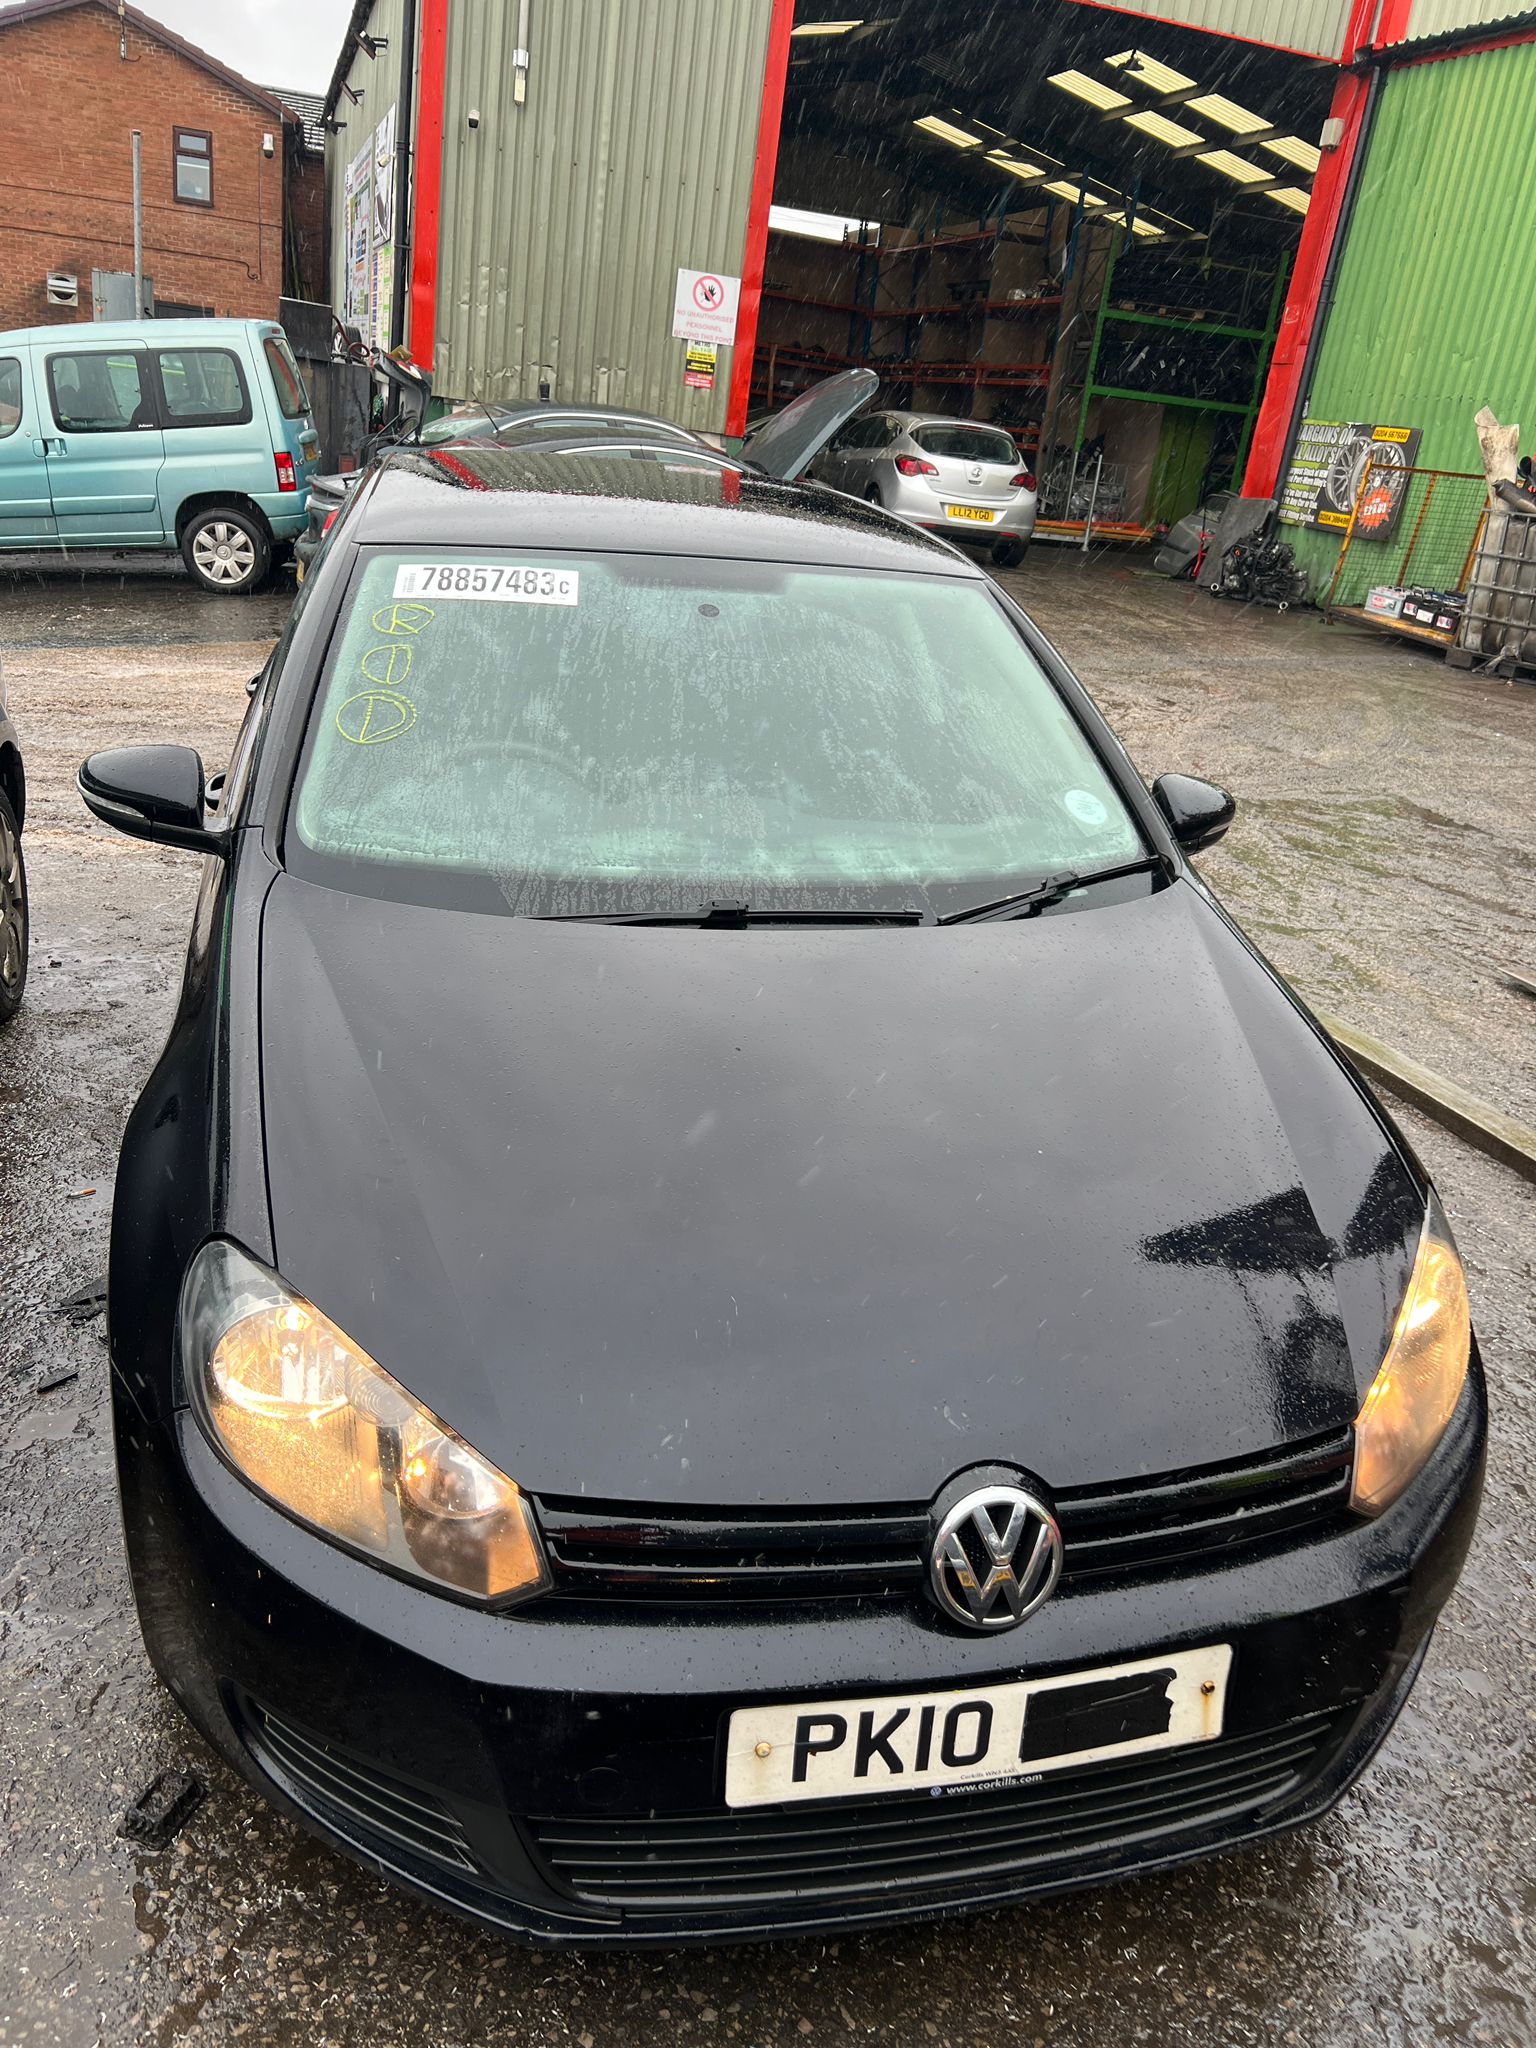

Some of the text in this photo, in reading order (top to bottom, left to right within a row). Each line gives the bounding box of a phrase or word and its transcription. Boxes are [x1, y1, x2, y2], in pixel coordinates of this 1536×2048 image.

[676, 309, 686, 317] NO
[686, 321, 722, 332] PERSONNEL
[674, 329, 700, 339] BEYOND
[700, 333, 714, 341] THIS
[1339, 427, 1356, 445] ON
[953, 506, 972, 518] LL12
[421, 566, 556, 596] 78857483
[946, 1773, 1043, 1796] www.corkills.com
